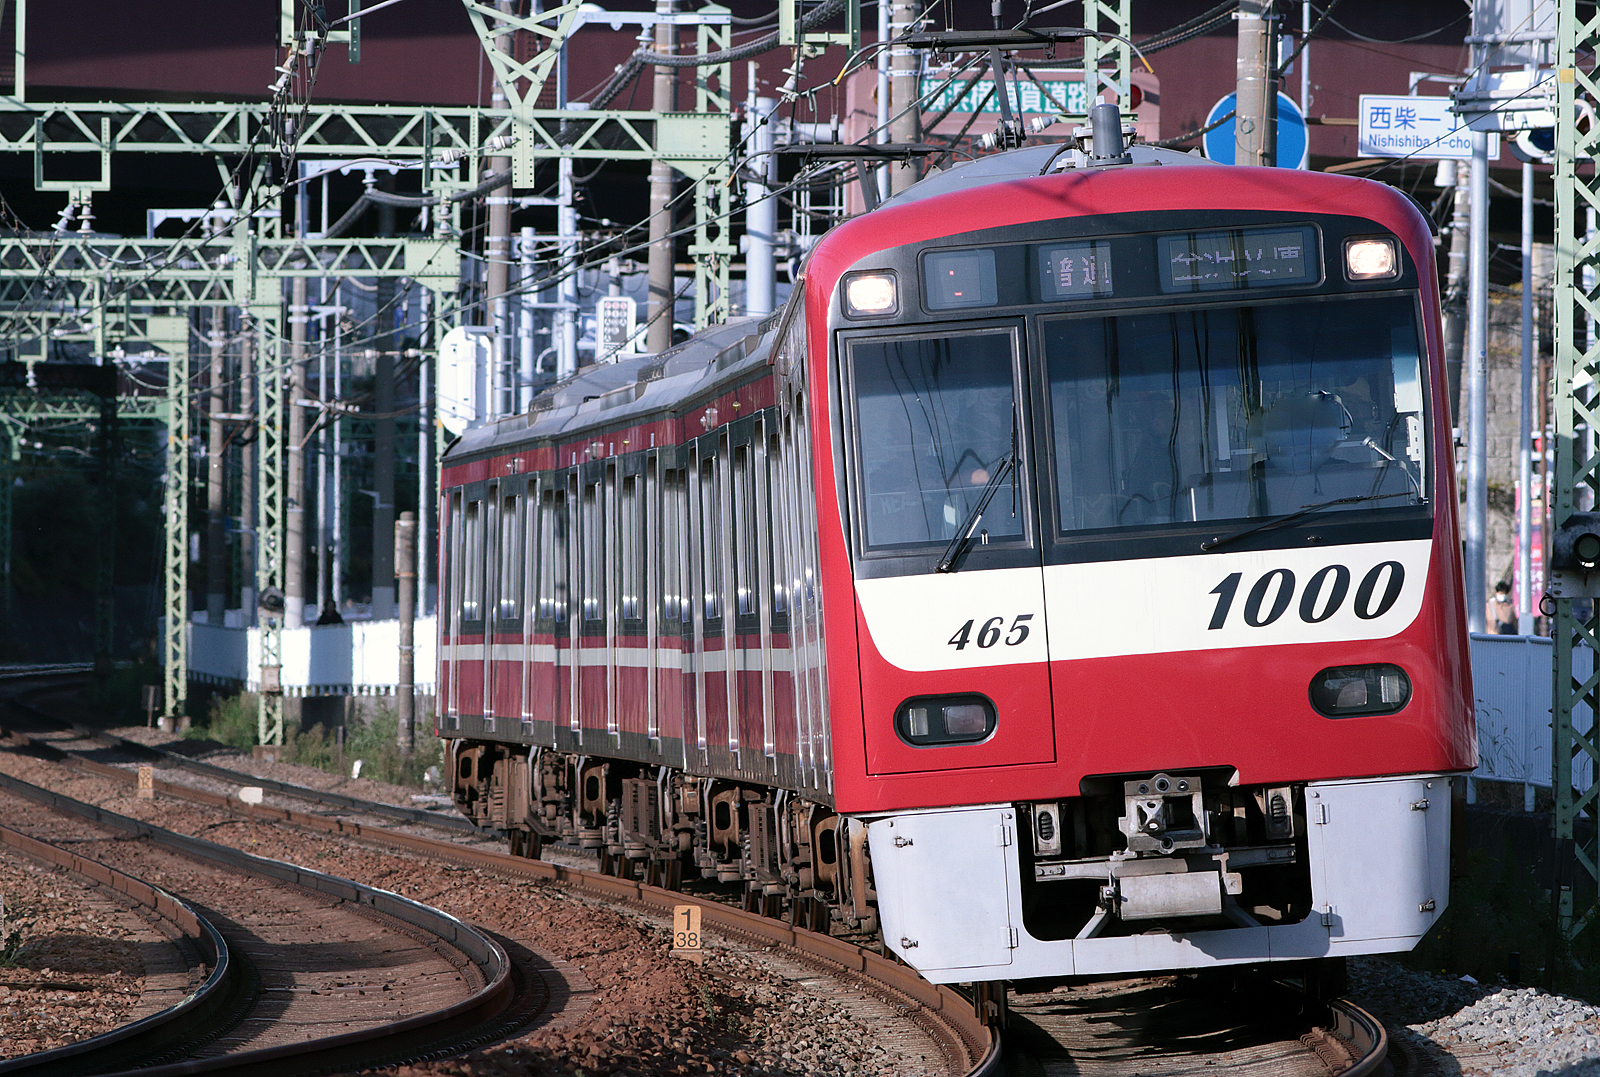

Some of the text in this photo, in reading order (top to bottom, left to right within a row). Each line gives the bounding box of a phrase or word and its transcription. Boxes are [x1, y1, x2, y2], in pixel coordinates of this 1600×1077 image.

[1370, 106, 1460, 131] 西柴一丁
[1369, 134, 1430, 148] Nishishiba
[1207, 560, 1406, 630] 1000
[947, 614, 1034, 651] 465
[681, 908, 691, 931] 1
[676, 932, 698, 948] 38
